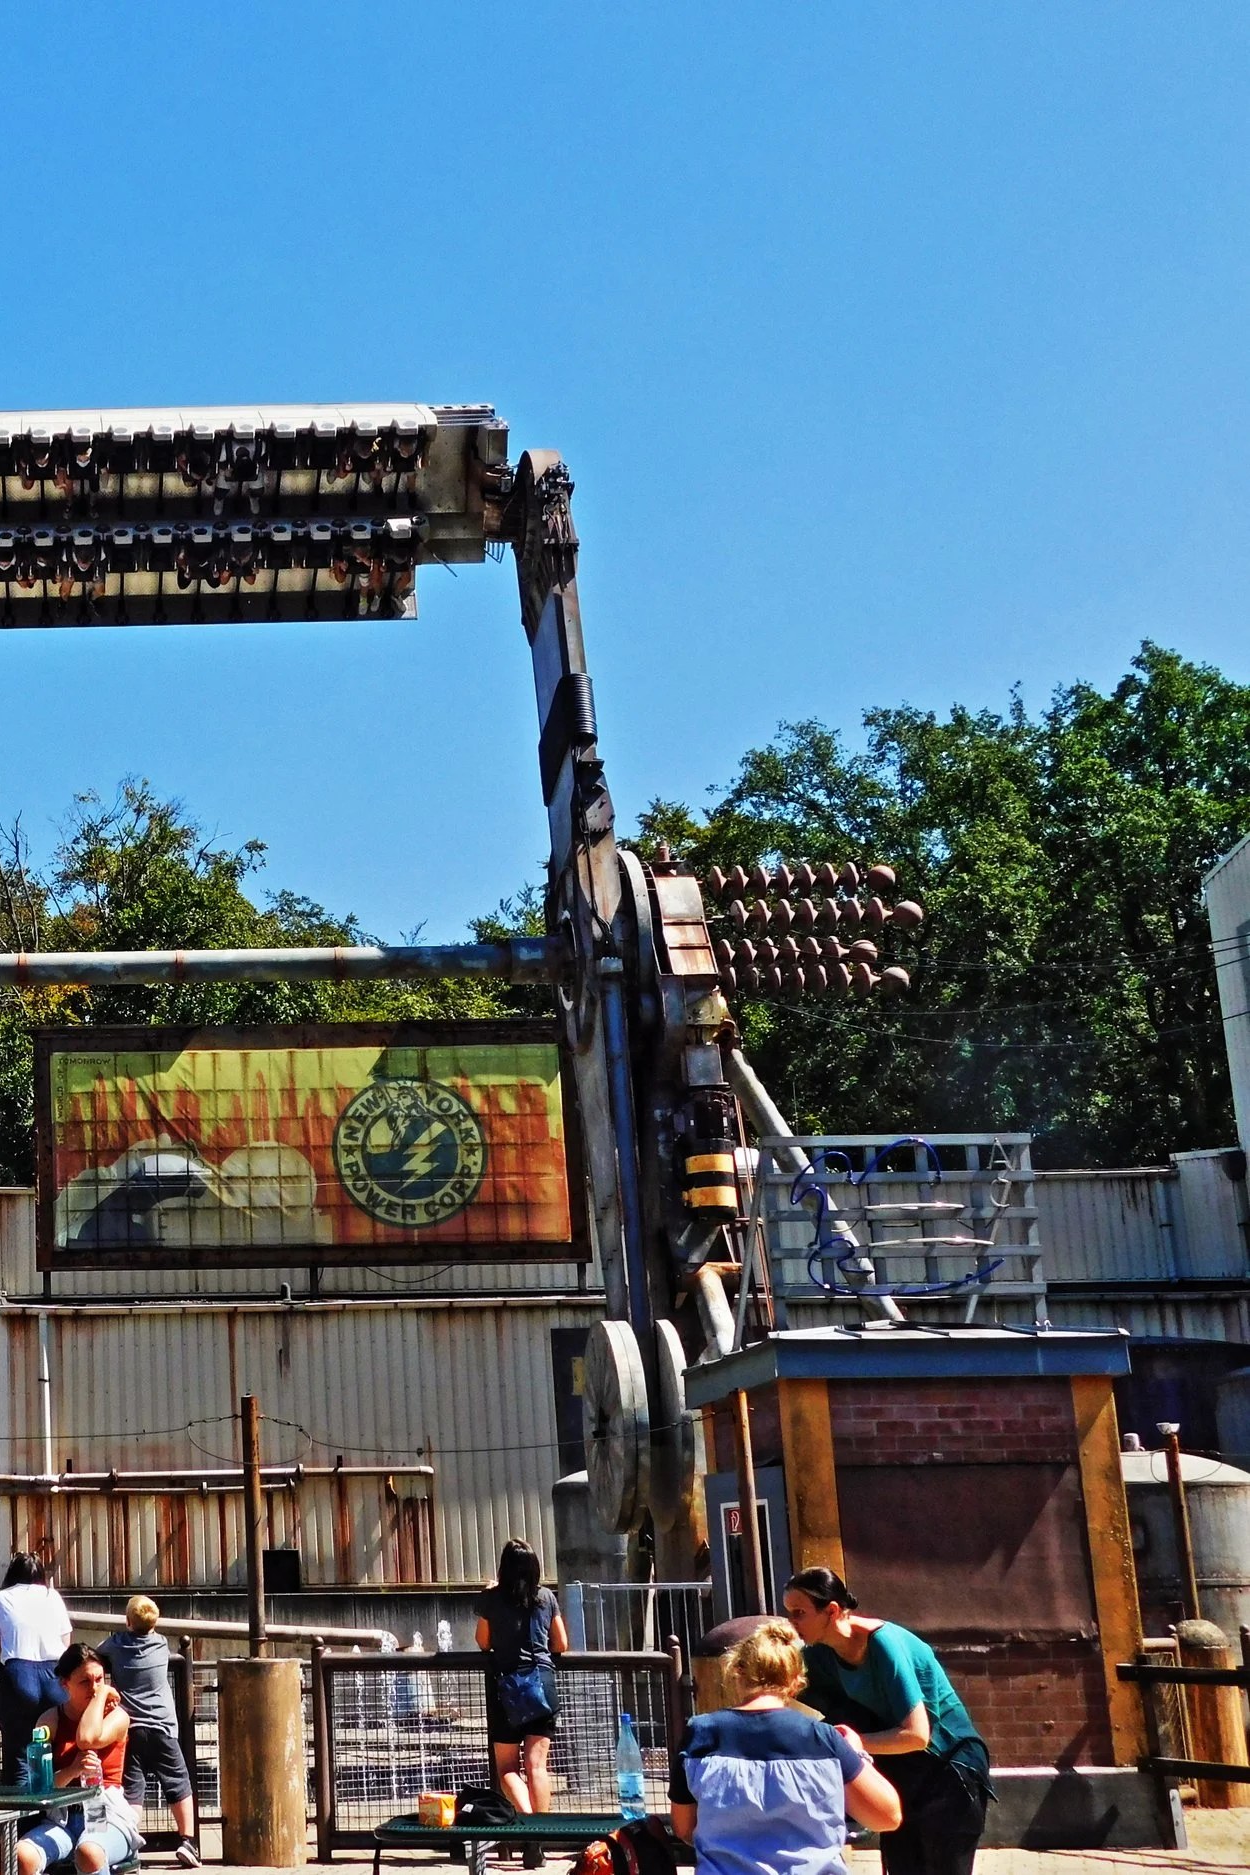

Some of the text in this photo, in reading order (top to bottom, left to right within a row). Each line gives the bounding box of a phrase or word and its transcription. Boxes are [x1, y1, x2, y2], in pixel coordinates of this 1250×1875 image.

[58, 1057, 111, 1066] TOMORROW
[343, 1087, 477, 1144] NEW YORK
[344, 1160, 417, 1221] POWER
